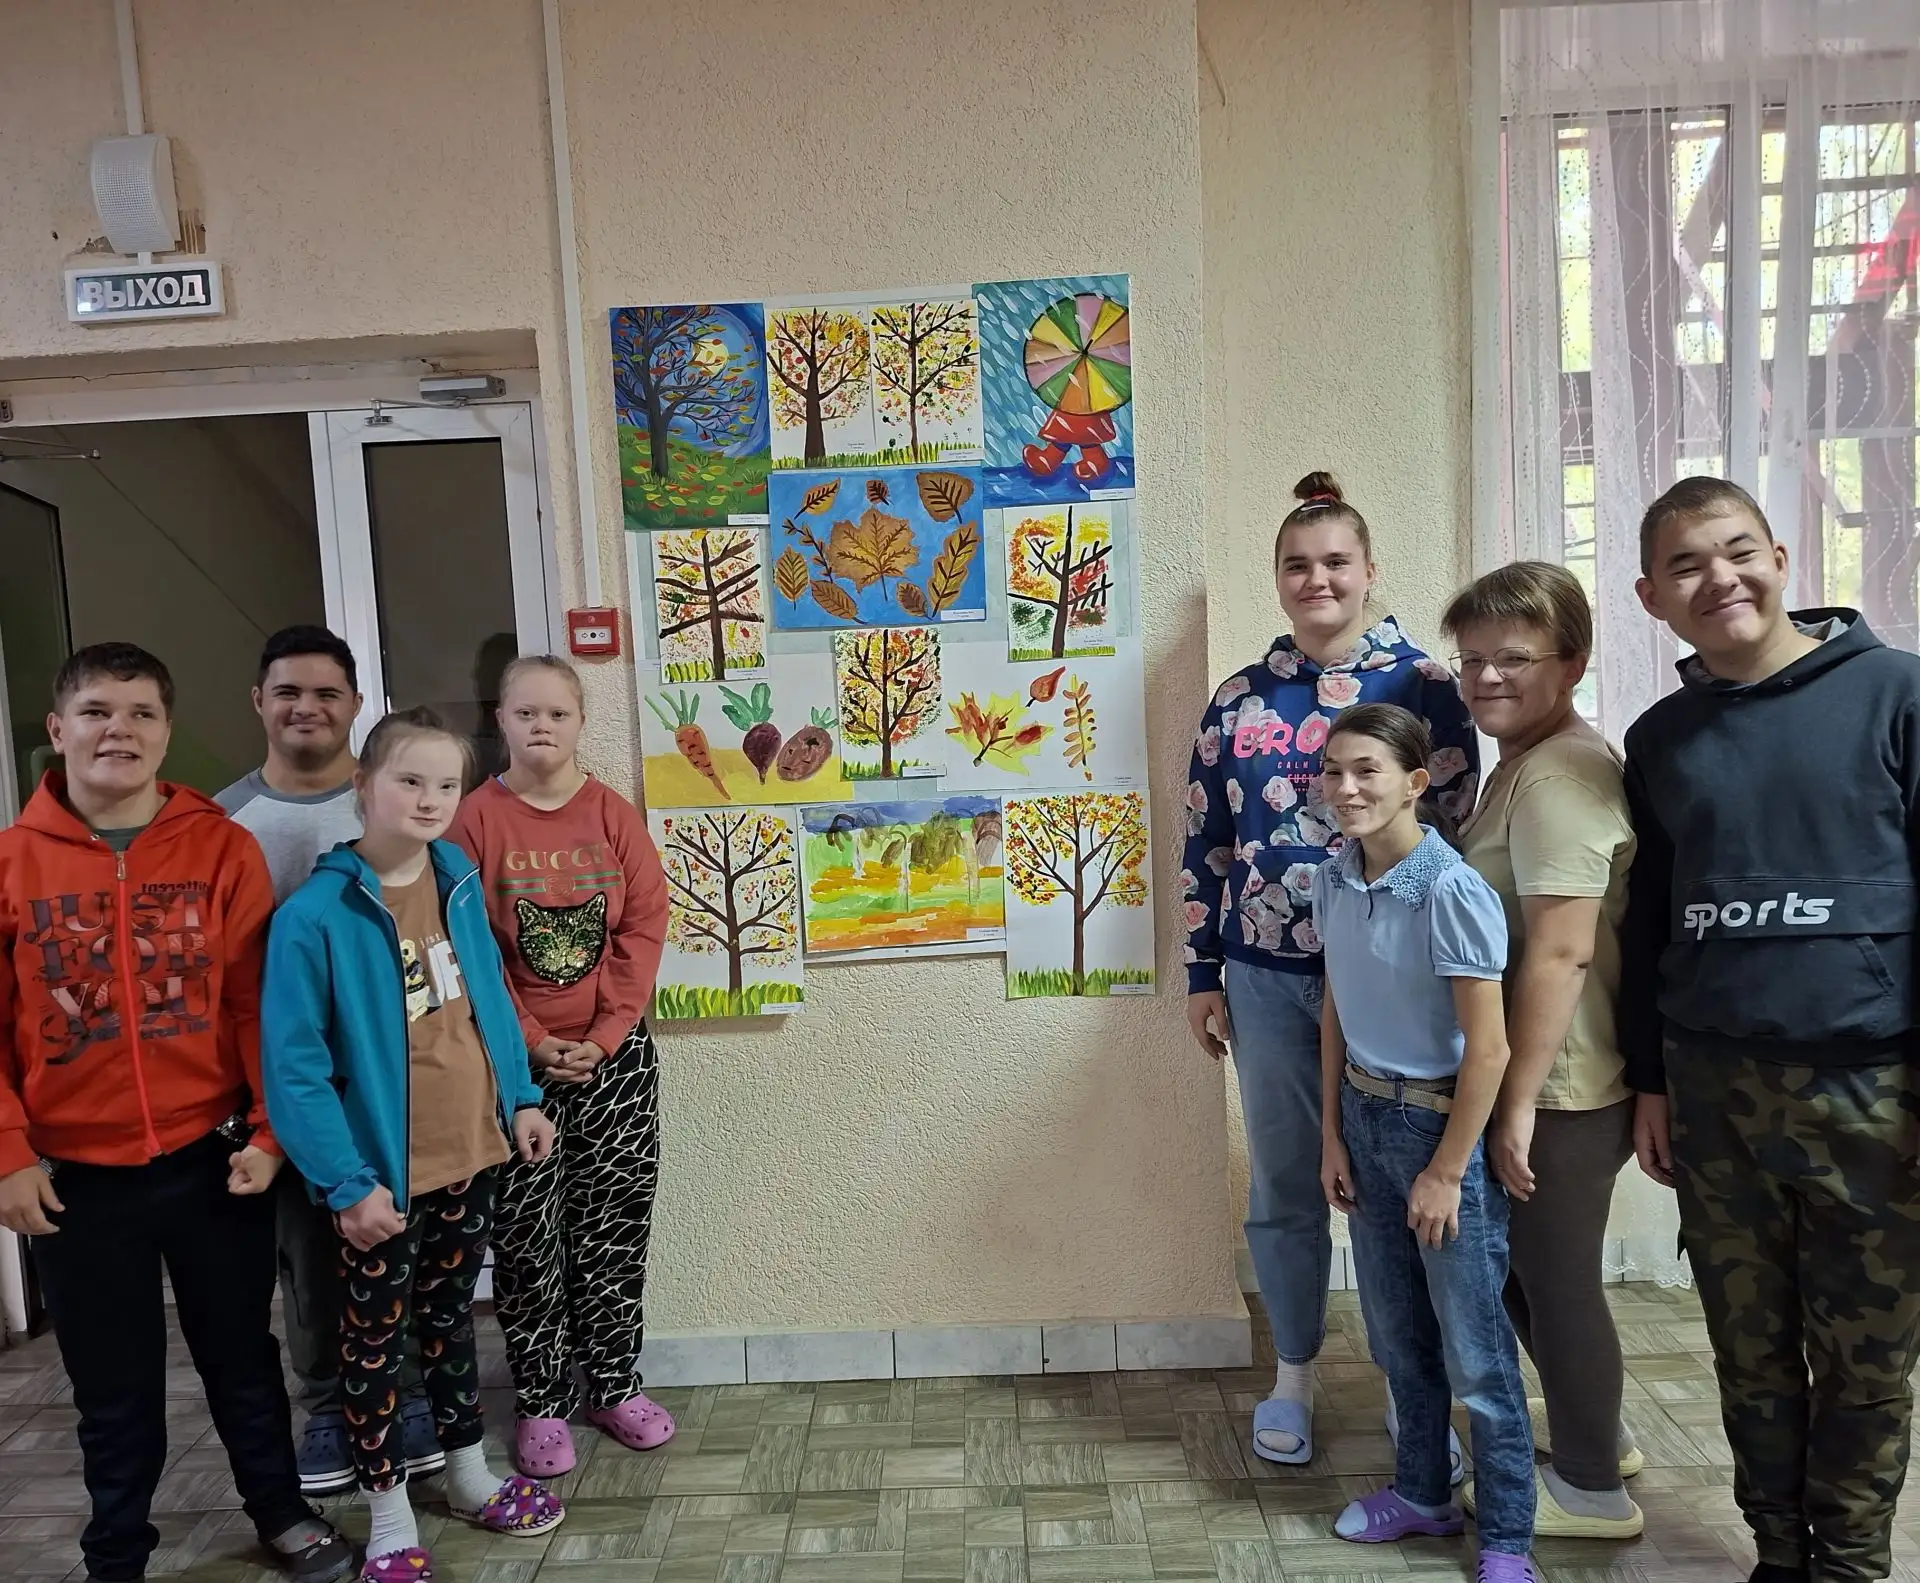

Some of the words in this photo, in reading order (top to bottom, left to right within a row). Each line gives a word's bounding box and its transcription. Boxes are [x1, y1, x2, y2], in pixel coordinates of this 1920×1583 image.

[81, 275, 206, 312] ВЫХОД
[506, 844, 604, 871] GUCCI
[1684, 892, 1835, 941] sports
